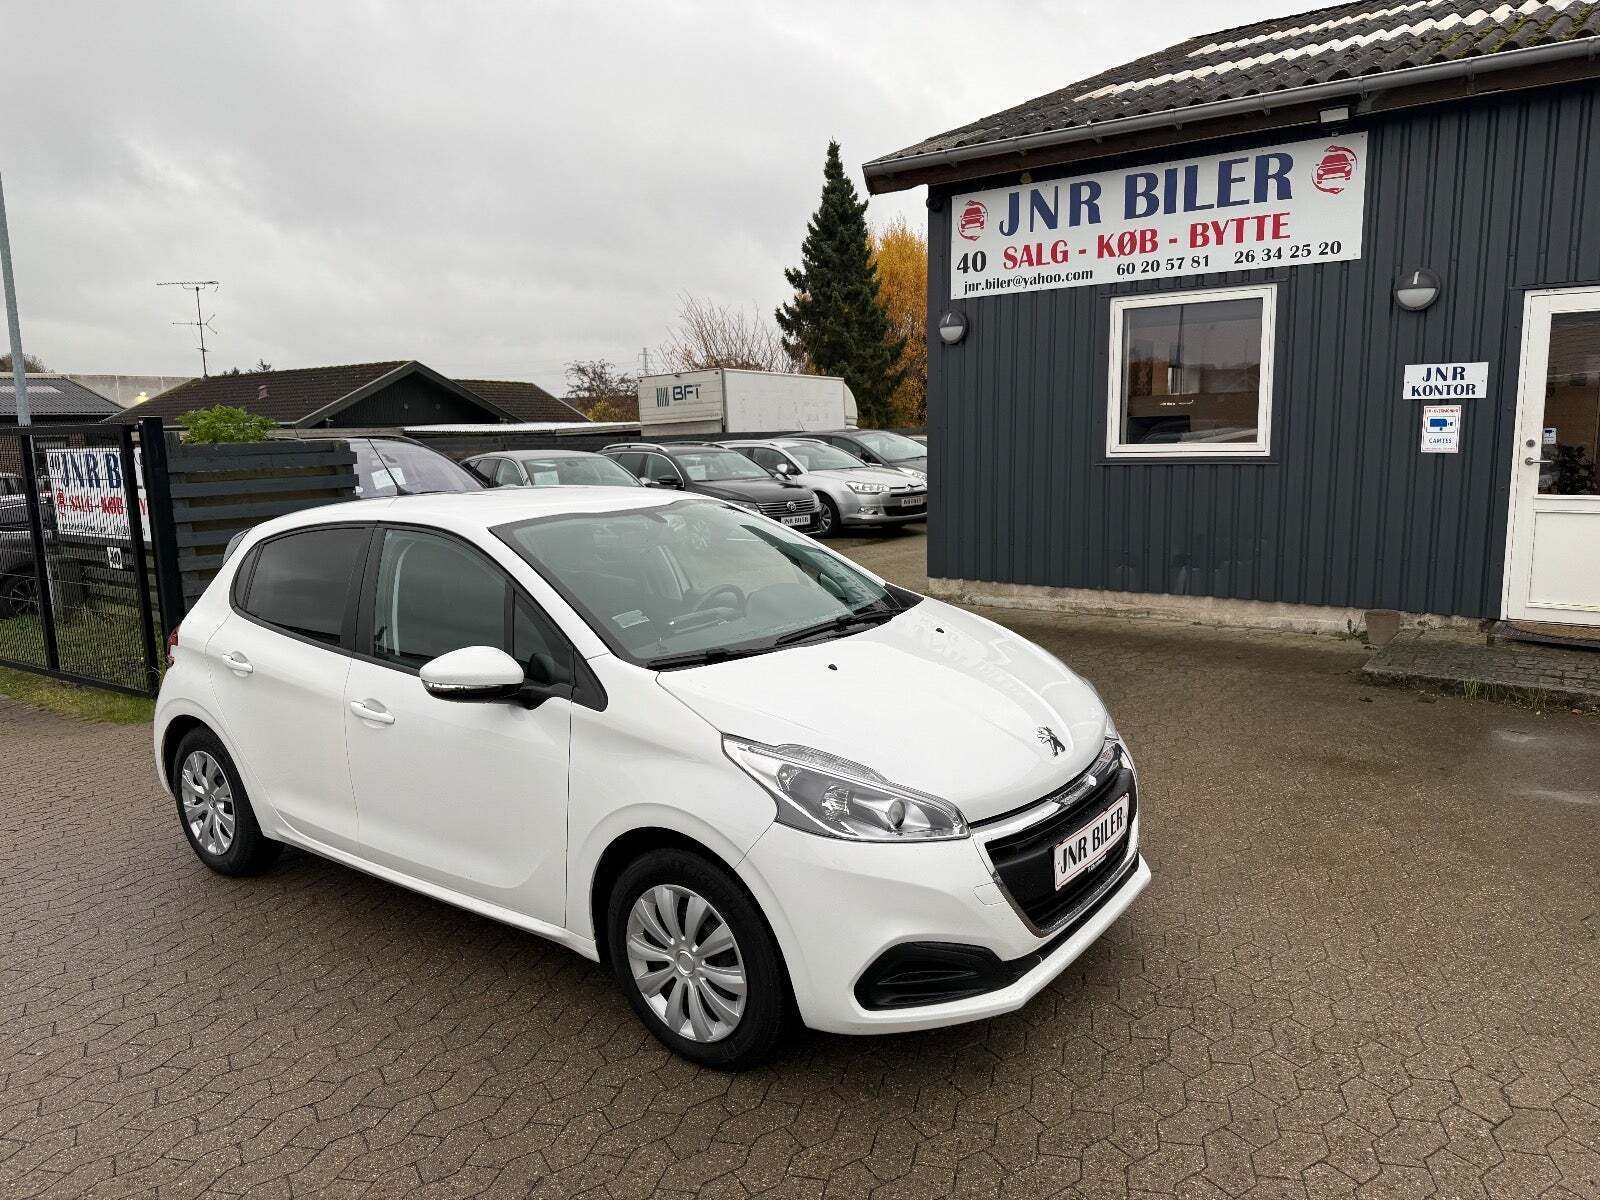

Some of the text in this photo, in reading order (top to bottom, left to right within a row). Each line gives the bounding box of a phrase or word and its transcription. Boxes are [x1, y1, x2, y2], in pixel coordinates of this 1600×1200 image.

[999, 152, 1294, 237] JNR BILER
[1003, 239, 1069, 270] SALG
[1097, 228, 1159, 259] KØB
[1189, 212, 1290, 249] BYTTE
[1234, 240, 1342, 265] 26 34 25 20
[956, 250, 987, 274] 40
[1116, 254, 1210, 276] 60 20 57 81
[964, 270, 1094, 295] jnr.biler@yahoo.com
[1422, 366, 1465, 382] JNR
[1411, 383, 1476, 397] KONTOR
[1060, 836, 1087, 874] JNR
[1092, 807, 1123, 852] BILER
